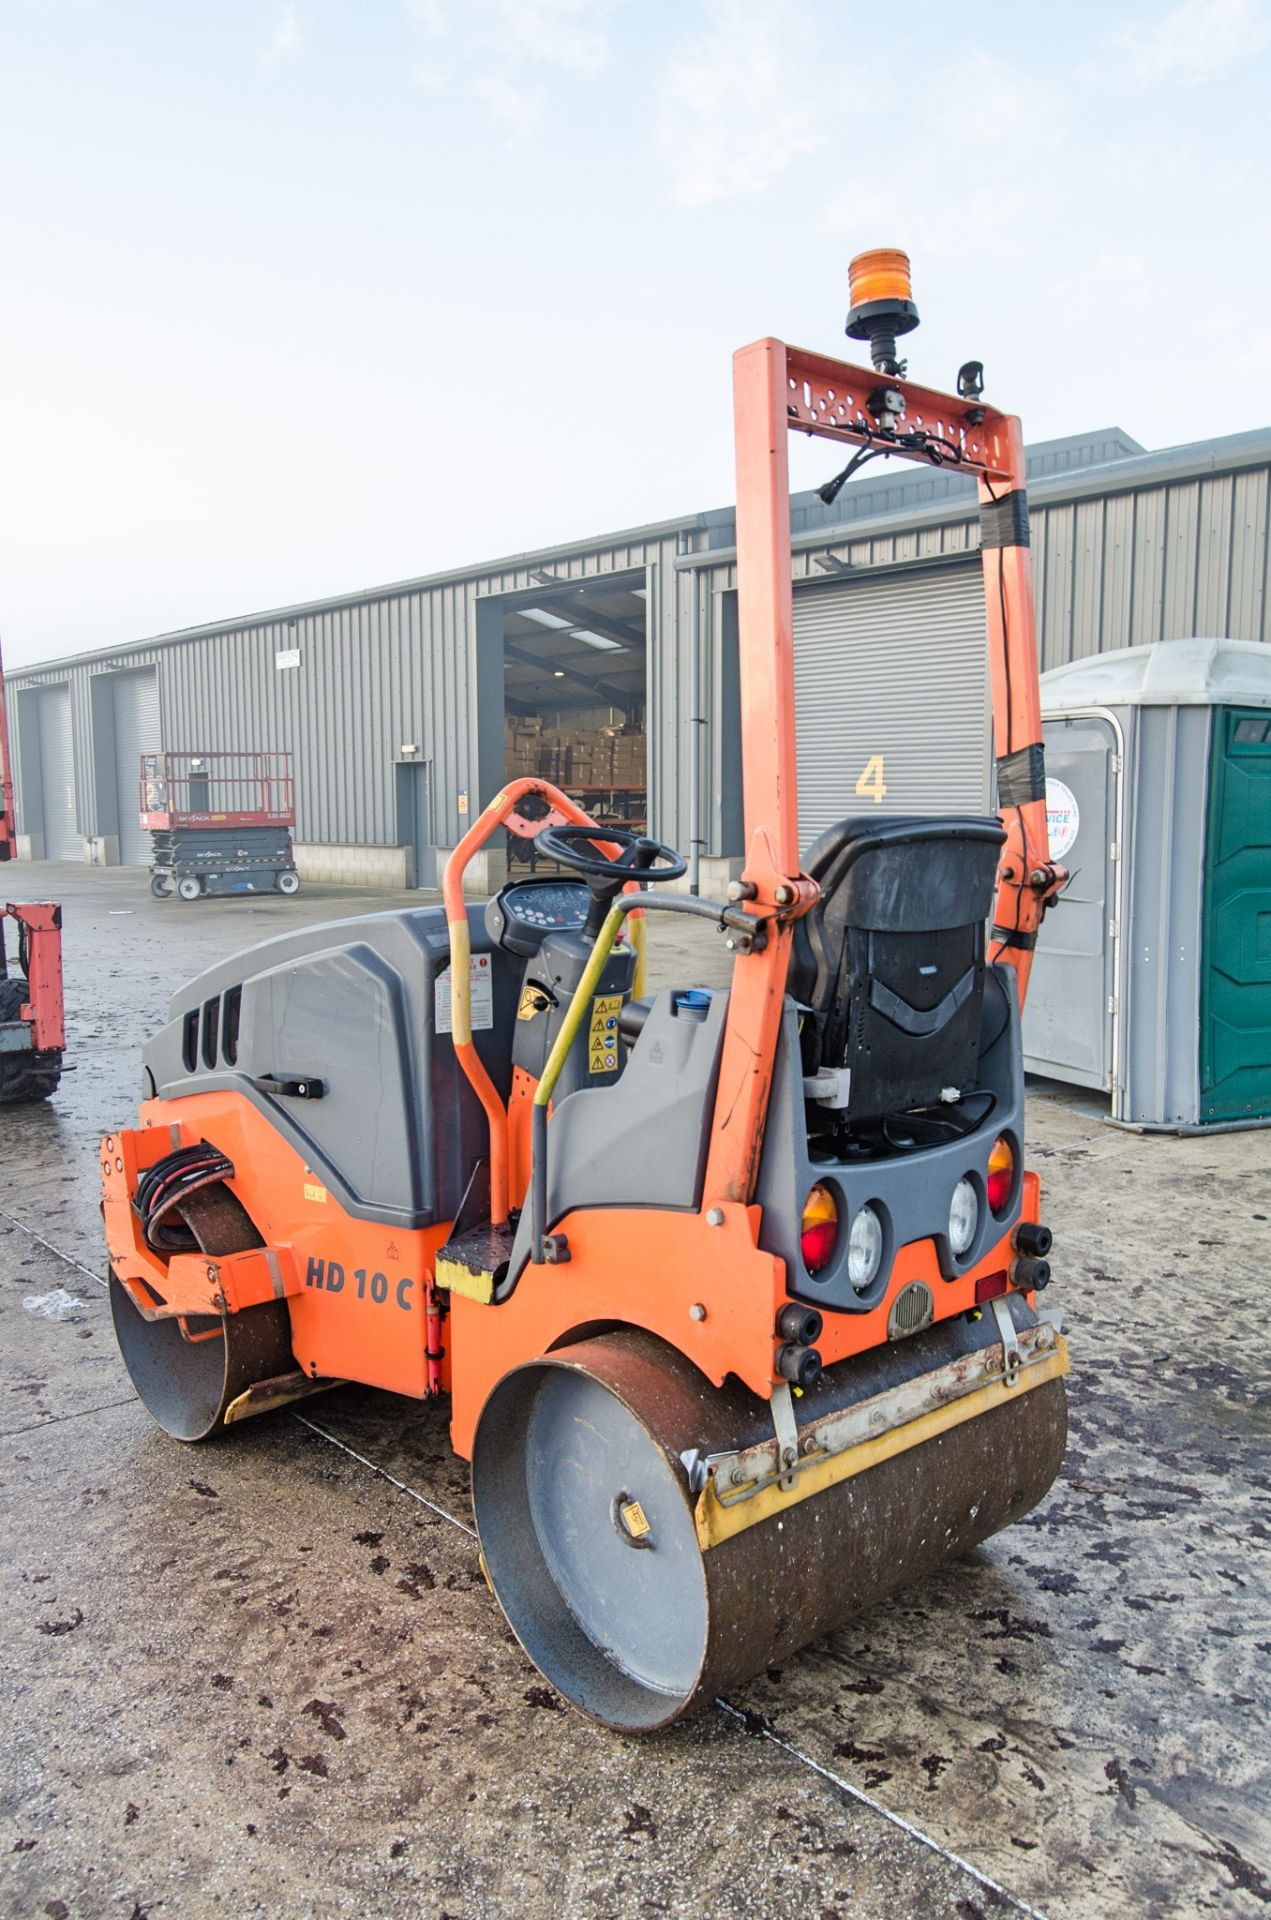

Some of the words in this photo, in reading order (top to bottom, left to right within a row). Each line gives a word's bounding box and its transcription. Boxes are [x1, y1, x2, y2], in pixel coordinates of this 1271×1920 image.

[855, 755, 887, 803] 4
[306, 1256, 345, 1293] HD
[354, 1269, 388, 1304] 10
[396, 1278, 414, 1311] C
